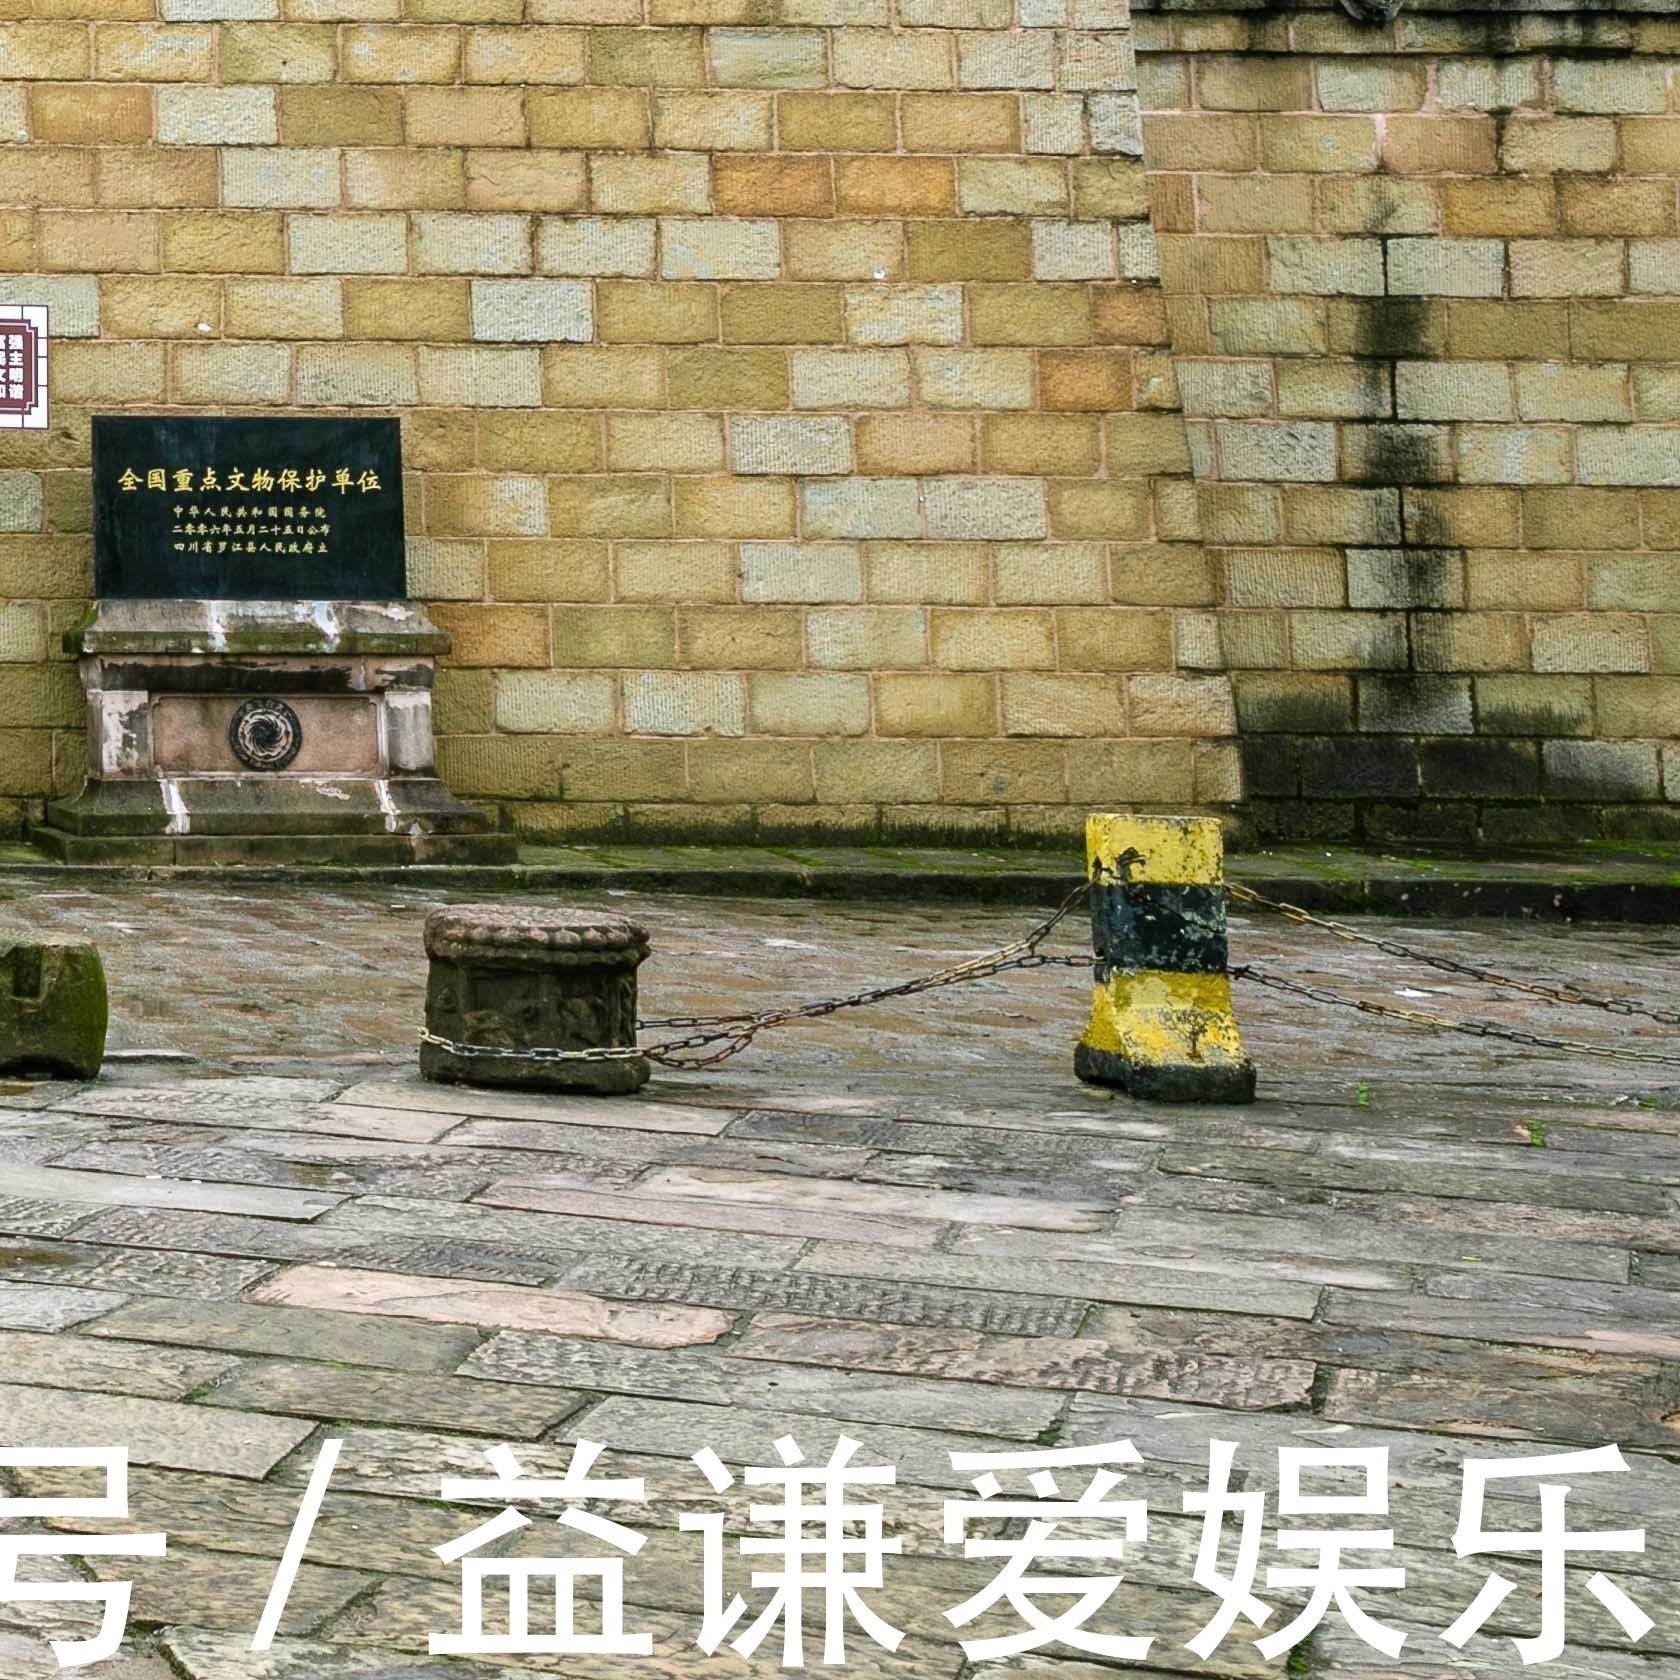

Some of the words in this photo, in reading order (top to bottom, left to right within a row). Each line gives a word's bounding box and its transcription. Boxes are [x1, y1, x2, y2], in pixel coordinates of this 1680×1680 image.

[117, 467, 382, 495] 全国重点文物保护单位
[173, 504, 327, 519] 中华人民共和国国务院
[171, 522, 331, 537] 二零零六年五月二十五日公布
[173, 540, 328, 554] 四川省罗江县人民政府立
